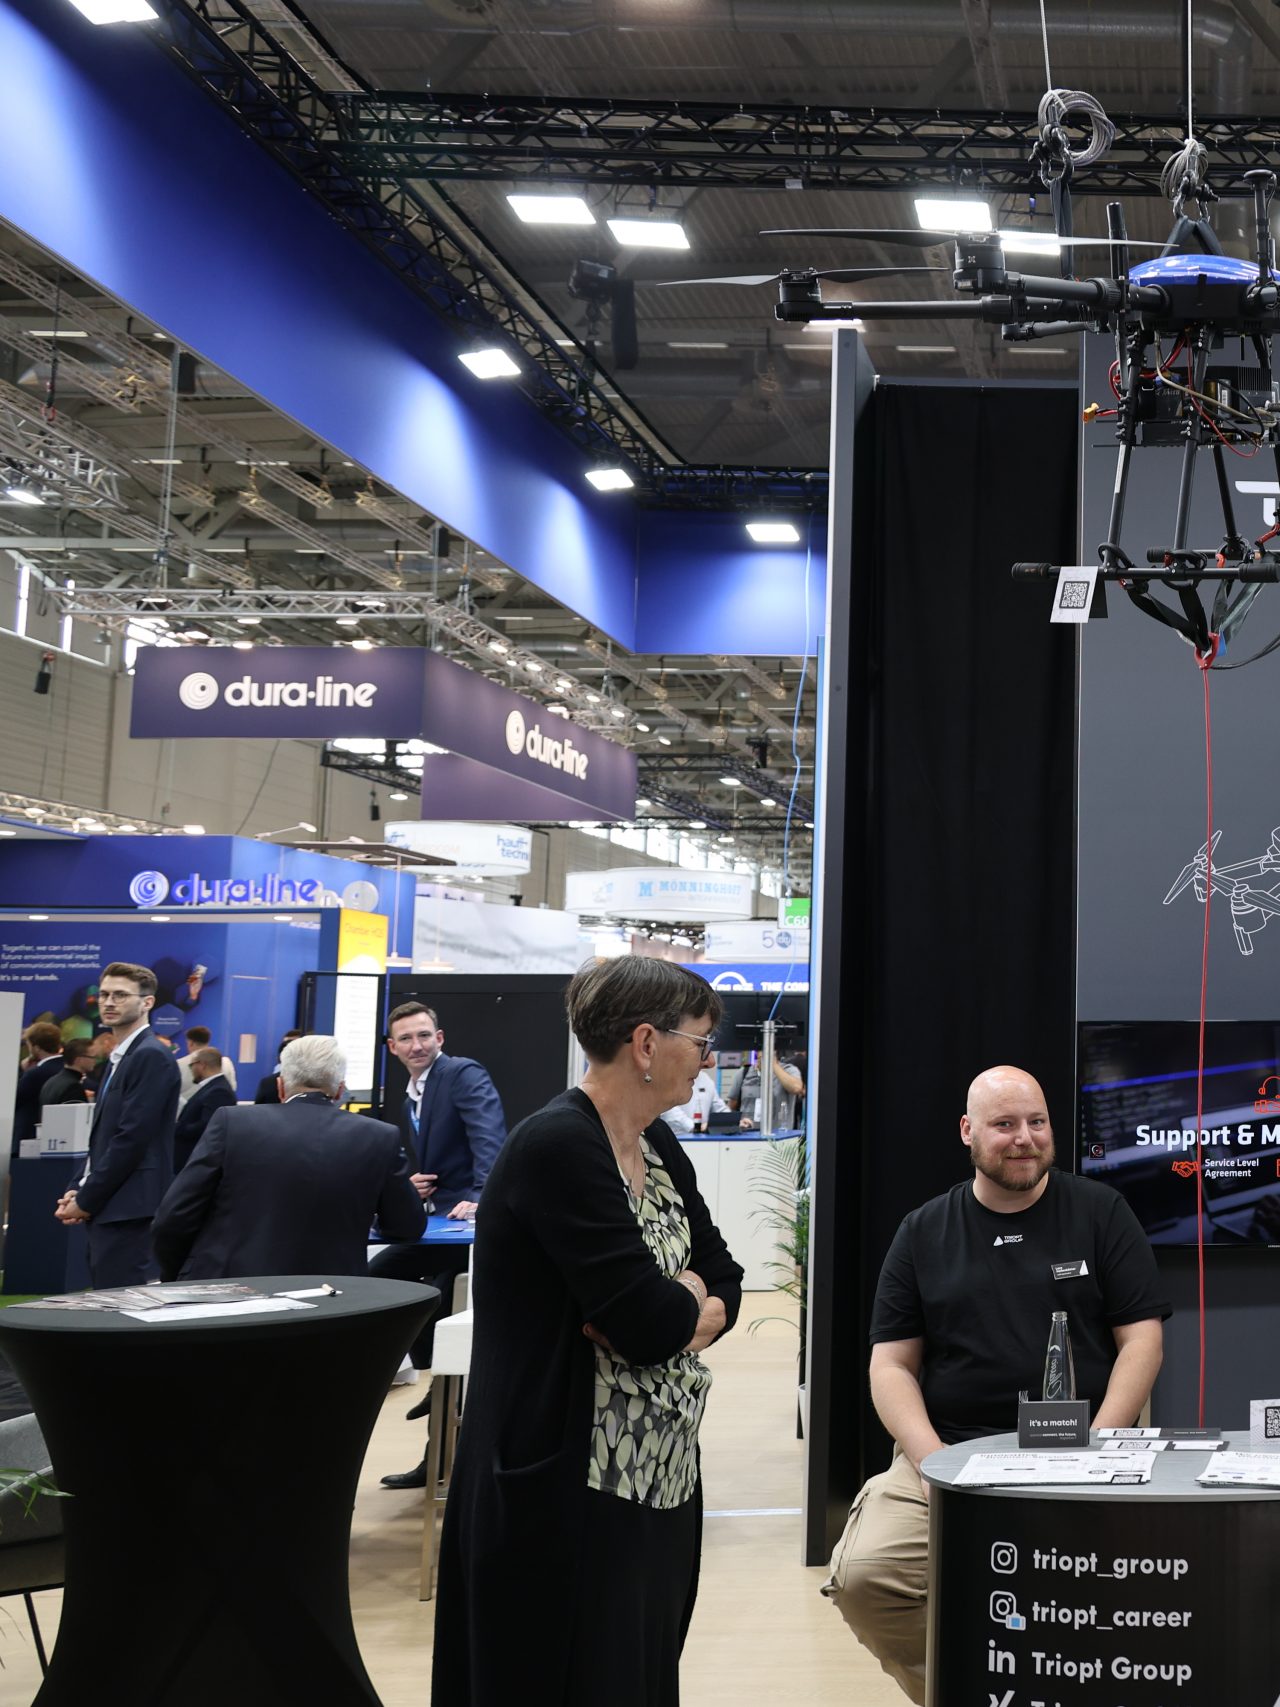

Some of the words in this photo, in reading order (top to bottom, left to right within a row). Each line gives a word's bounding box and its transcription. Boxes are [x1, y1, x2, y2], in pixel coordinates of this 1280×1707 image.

[1135, 1124, 1231, 1151] Support
[1237, 1124, 1254, 1145] &
[1205, 1158, 1234, 1167] Service
[1237, 1158, 1259, 1167] Level
[1205, 1169, 1251, 1179] Agreement
[1029, 1419, 1041, 1427] it's
[1049, 1419, 1078, 1427] match!
[1033, 1547, 1189, 1580] triopt_group
[1032, 1600, 1192, 1630] triopt_career
[1032, 1651, 1102, 1684] Triopt
[1111, 1656, 1192, 1686] Group
